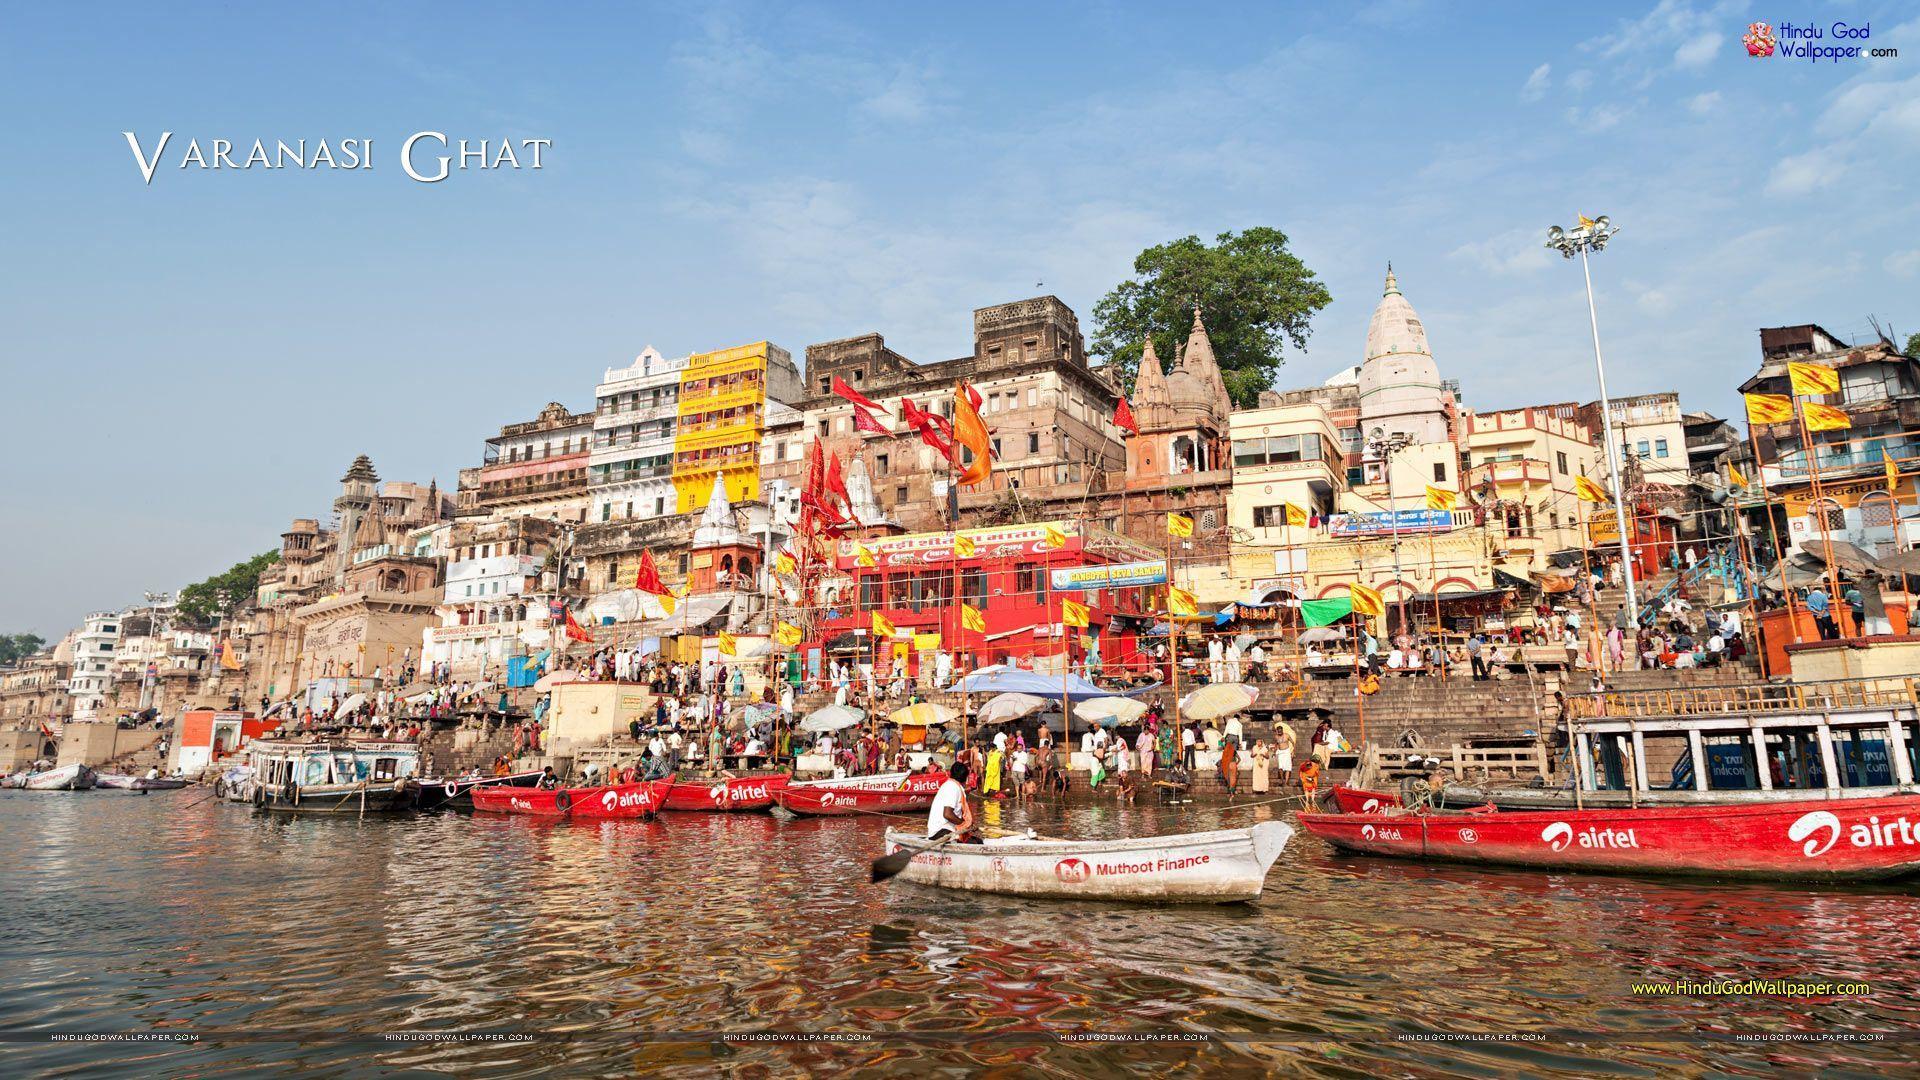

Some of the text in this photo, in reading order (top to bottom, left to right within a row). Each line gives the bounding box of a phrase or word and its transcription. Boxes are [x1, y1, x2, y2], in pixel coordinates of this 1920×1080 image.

[1111, 569, 1131, 579] SEVA
[1134, 565, 1163, 577] SAMITI
[731, 783, 769, 801] airtel
[862, 780, 898, 790] Finance
[913, 780, 940, 792] airtel
[619, 789, 651, 807] airtel
[835, 795, 857, 806] airtel
[1378, 828, 1403, 841] airtel
[1461, 829, 1475, 843] 12
[1579, 826, 1639, 849] airtel
[993, 860, 1003, 872] 13
[1096, 853, 1210, 876] Muthoot Finance
